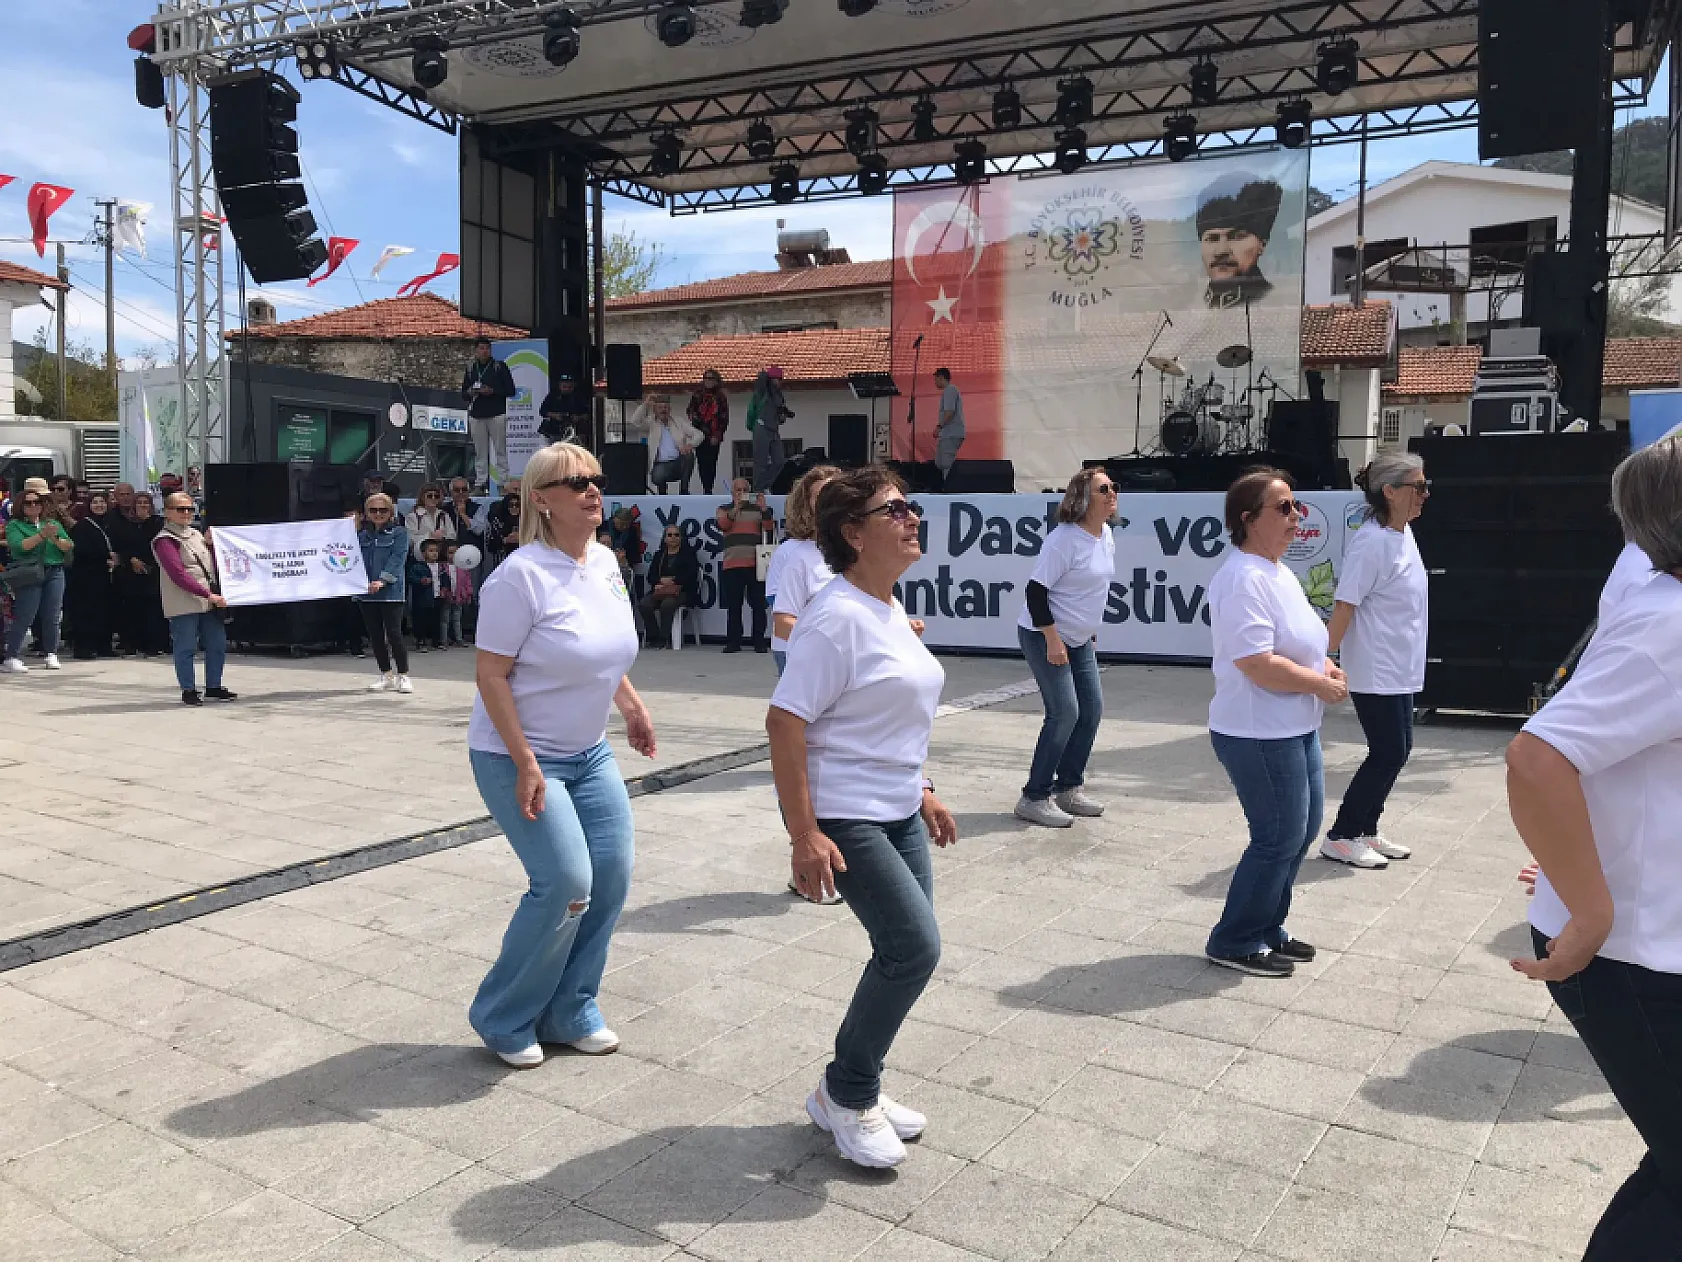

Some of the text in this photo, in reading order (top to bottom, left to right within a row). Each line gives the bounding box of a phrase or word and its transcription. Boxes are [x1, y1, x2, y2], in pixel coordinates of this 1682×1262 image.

[1049, 287, 1112, 307] MUĞLA
[431, 417, 466, 432] GEKA
[1154, 515, 1226, 558] ve
